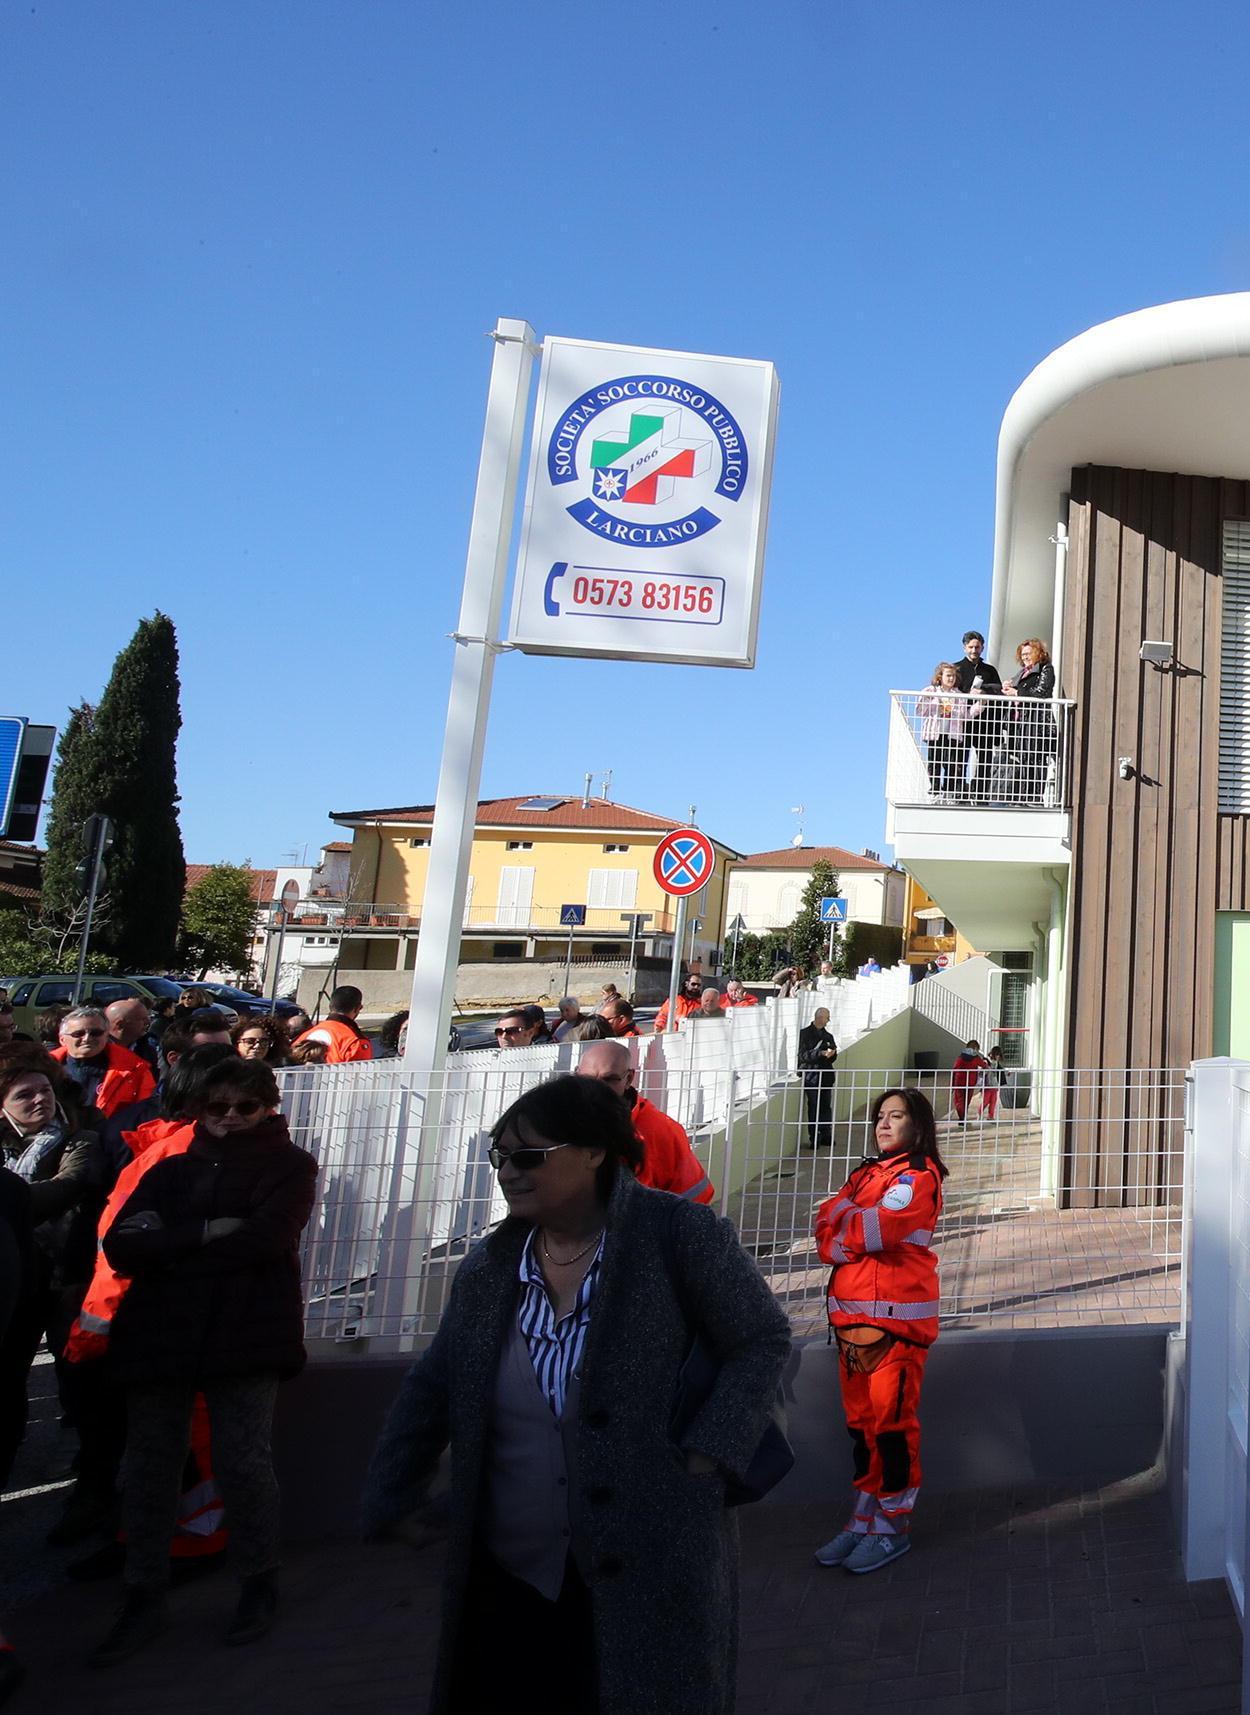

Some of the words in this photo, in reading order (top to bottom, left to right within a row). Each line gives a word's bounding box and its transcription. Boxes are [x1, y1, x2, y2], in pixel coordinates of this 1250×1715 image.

[555, 398, 597, 476] SOCIETA'
[597, 381, 706, 409] SOCCORSO
[703, 405, 742, 492] PUBBLICO
[629, 446, 659, 473] 1966
[585, 511, 698, 543] LARCIANO
[573, 576, 633, 608] 0573
[641, 582, 714, 614] 83156
